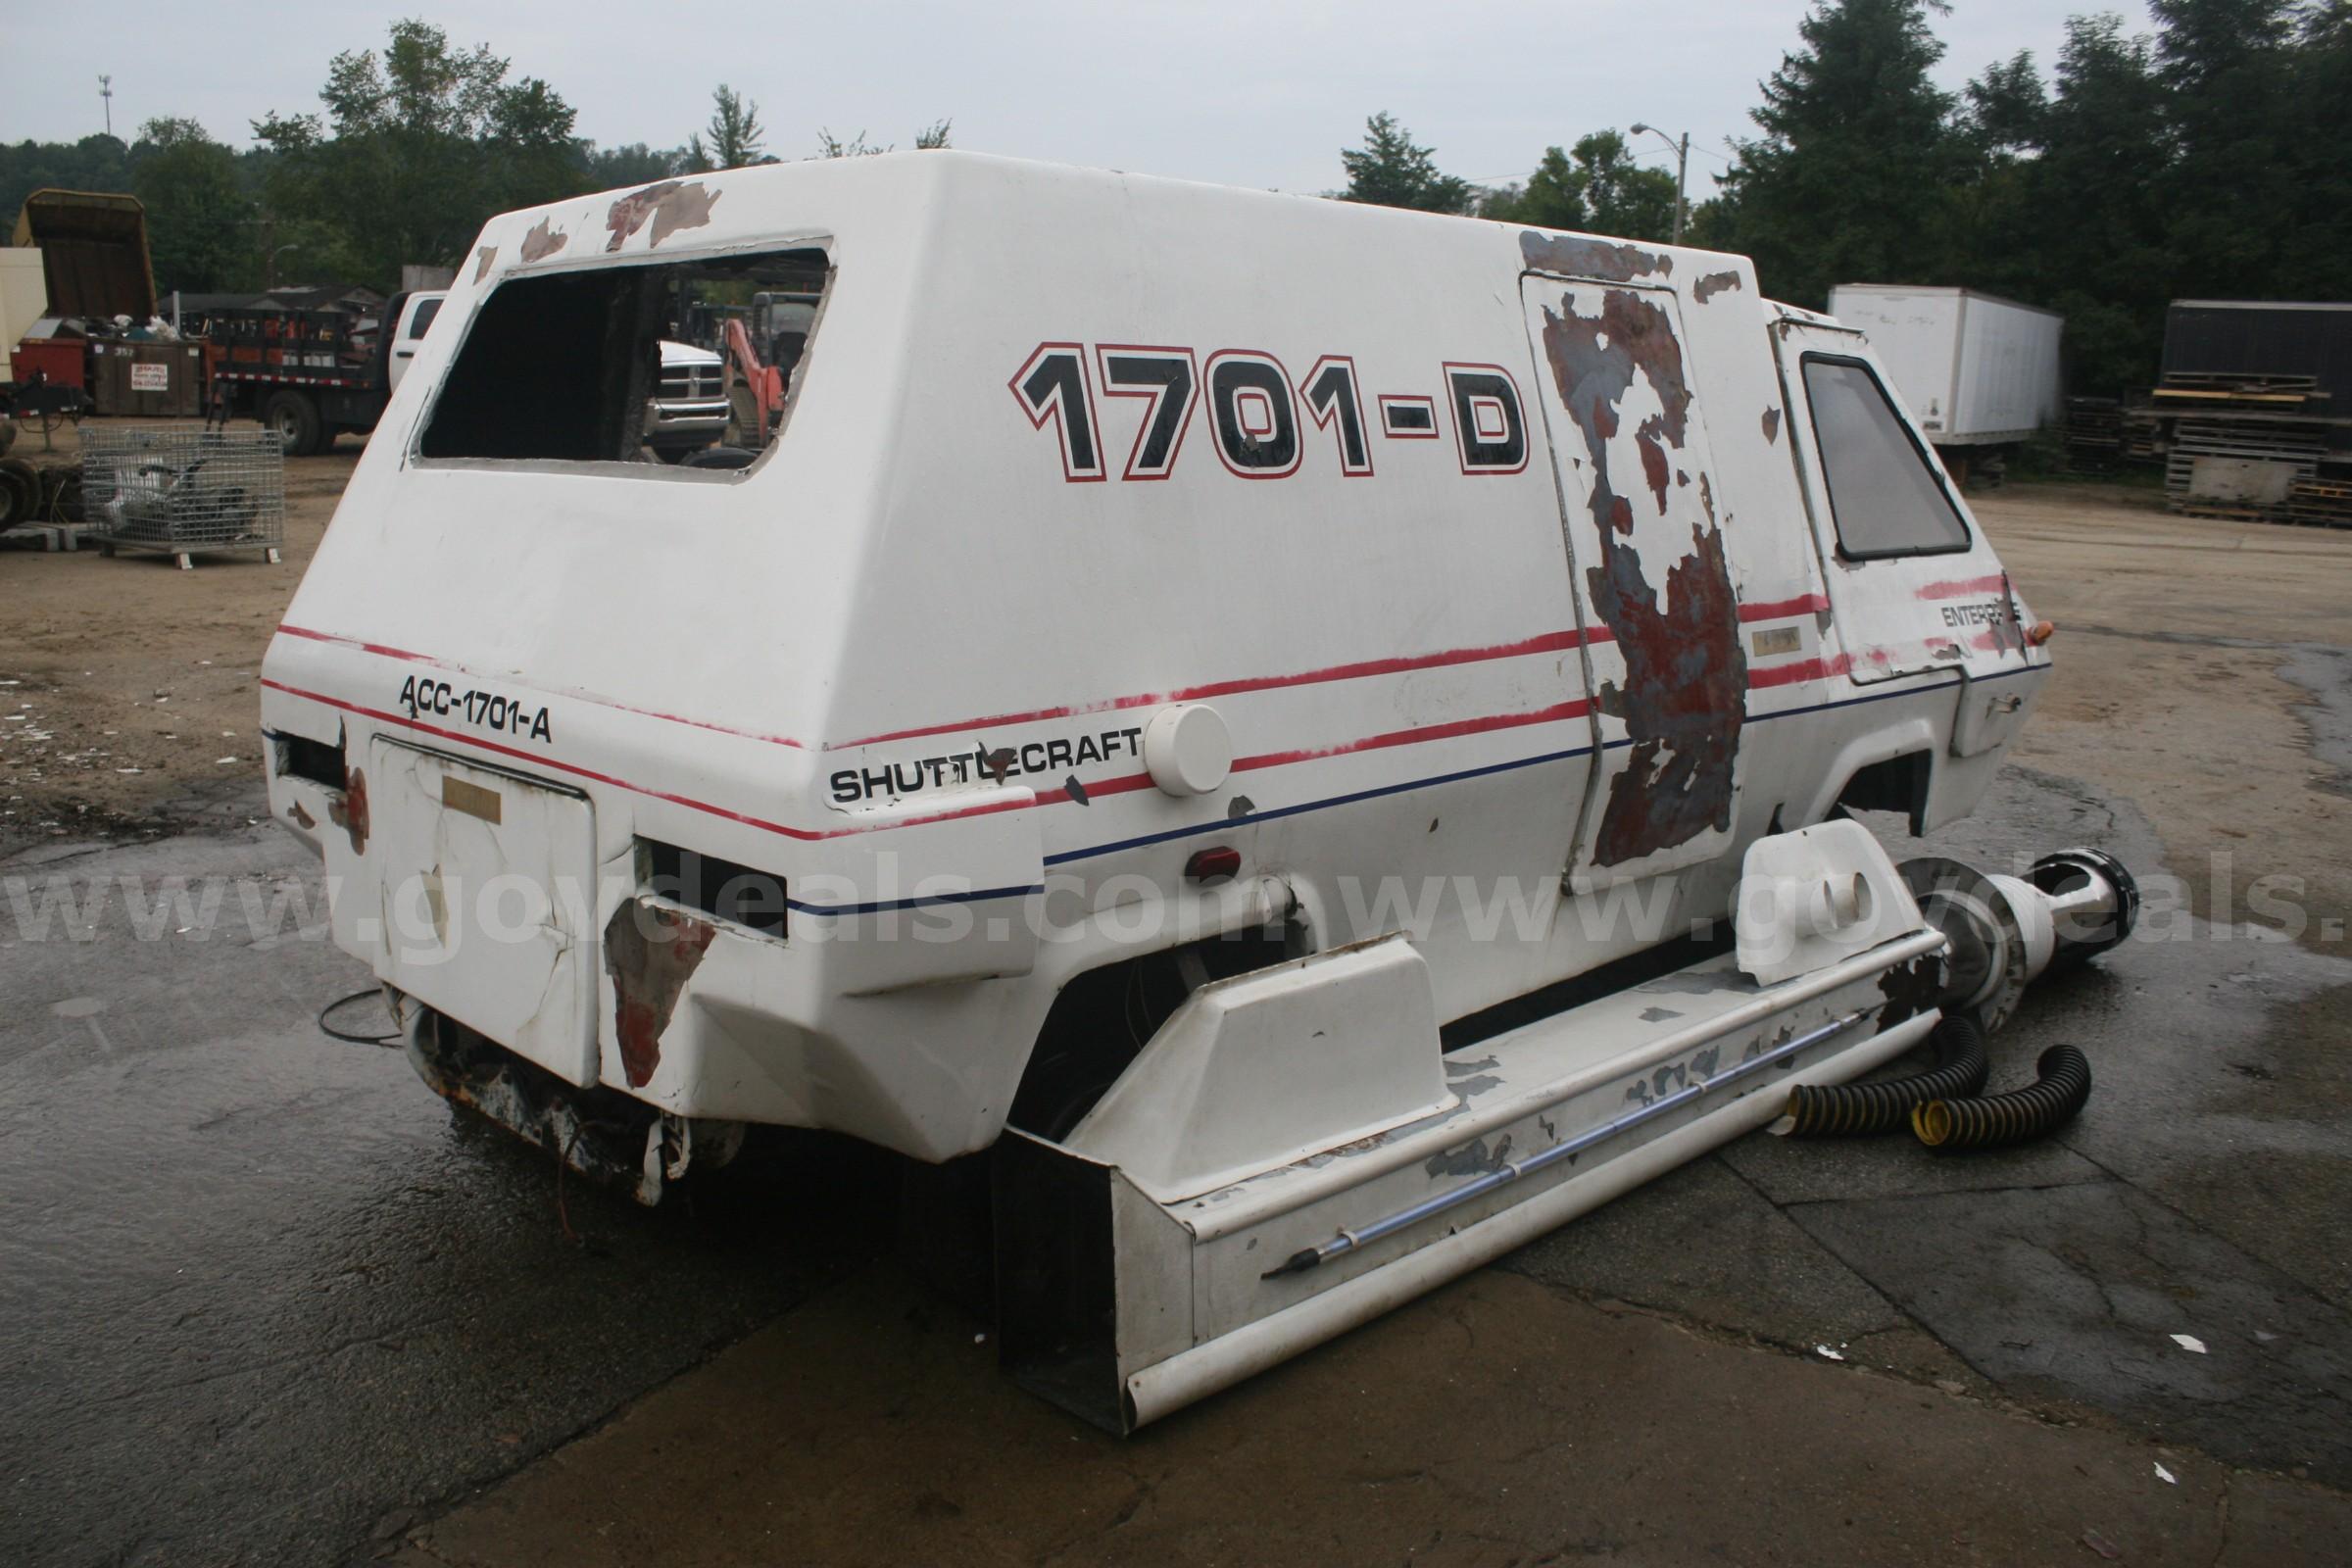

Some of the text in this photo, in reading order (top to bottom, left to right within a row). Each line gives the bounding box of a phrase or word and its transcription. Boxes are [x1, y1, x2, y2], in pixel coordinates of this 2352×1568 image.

[1007, 342, 1530, 483] 1701-D
[1941, 601, 2022, 627] ENTERPE
[399, 675, 552, 744] ACC-1701-A
